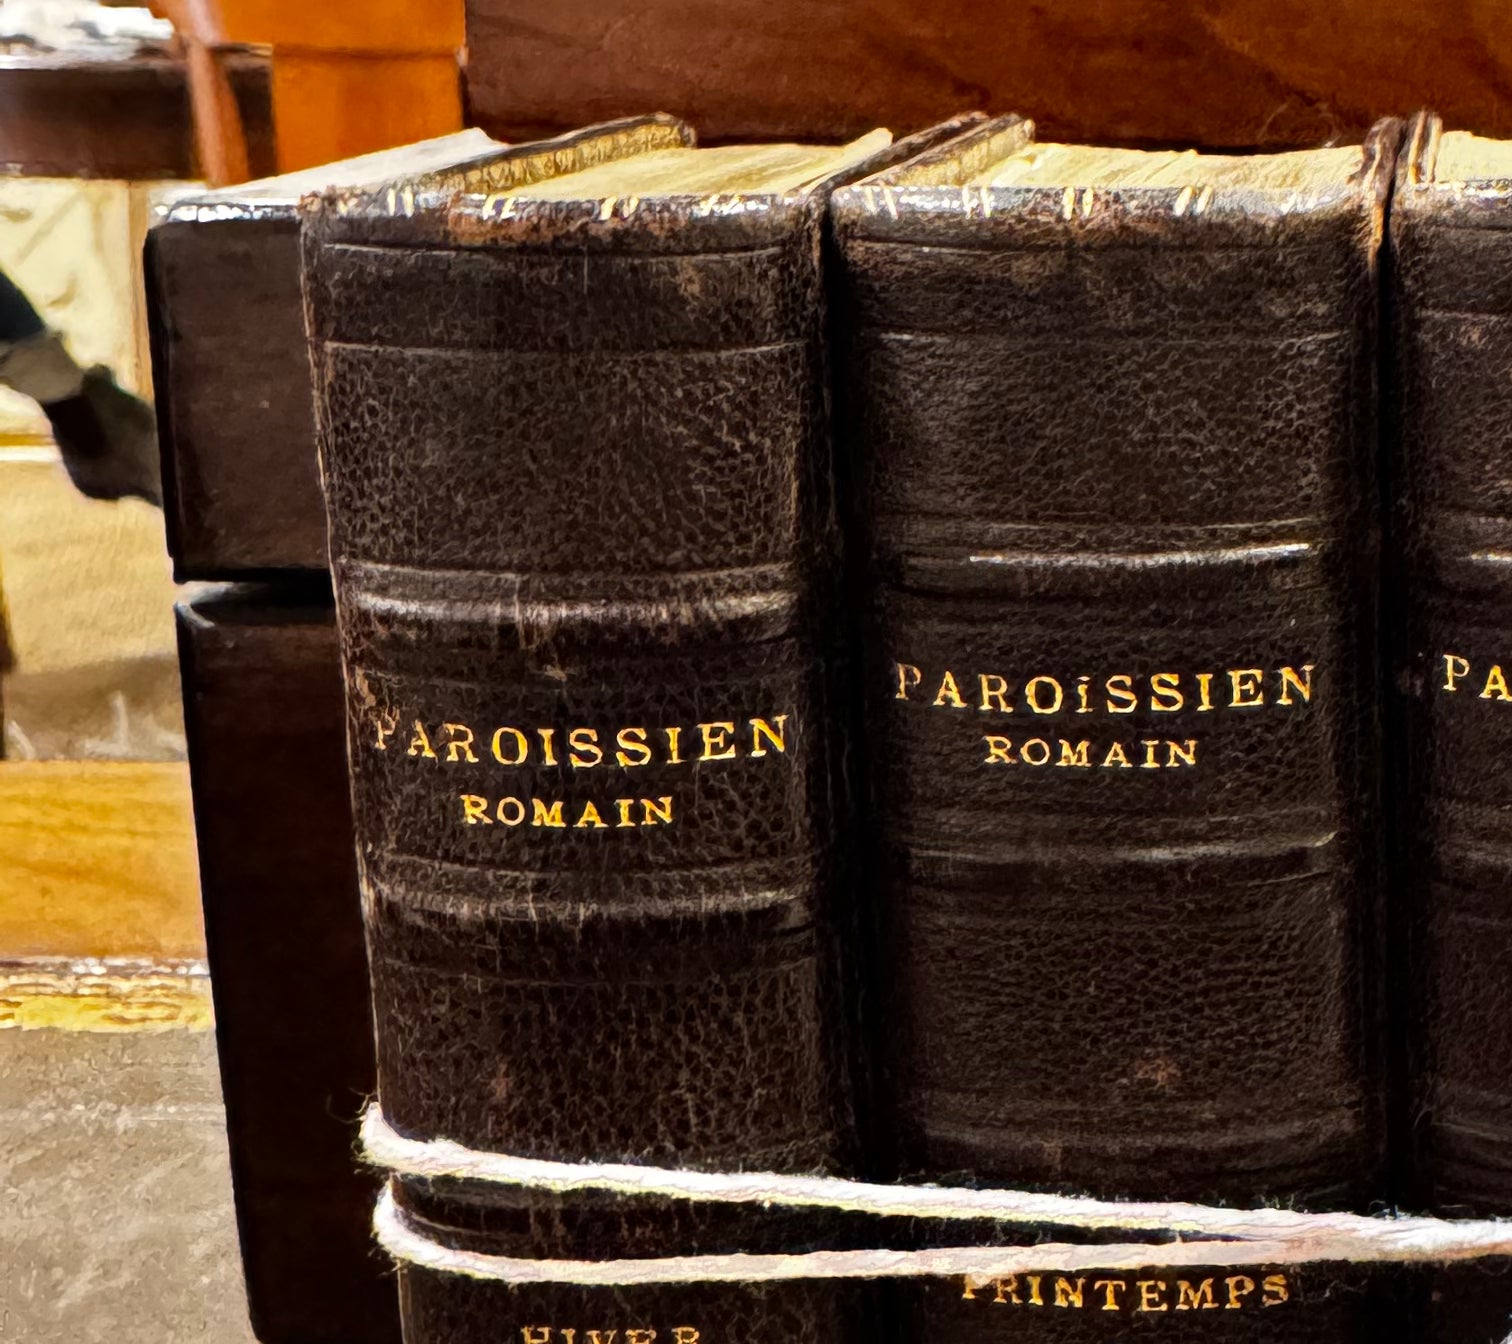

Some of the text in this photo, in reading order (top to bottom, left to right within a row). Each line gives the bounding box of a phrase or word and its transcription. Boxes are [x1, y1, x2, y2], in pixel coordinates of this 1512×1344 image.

[895, 662, 1315, 715] PAROISSIEN
[372, 706, 788, 768] PAROISSIEN
[983, 735, 1199, 769] ROMAIN
[460, 793, 674, 829] ROMAIN
